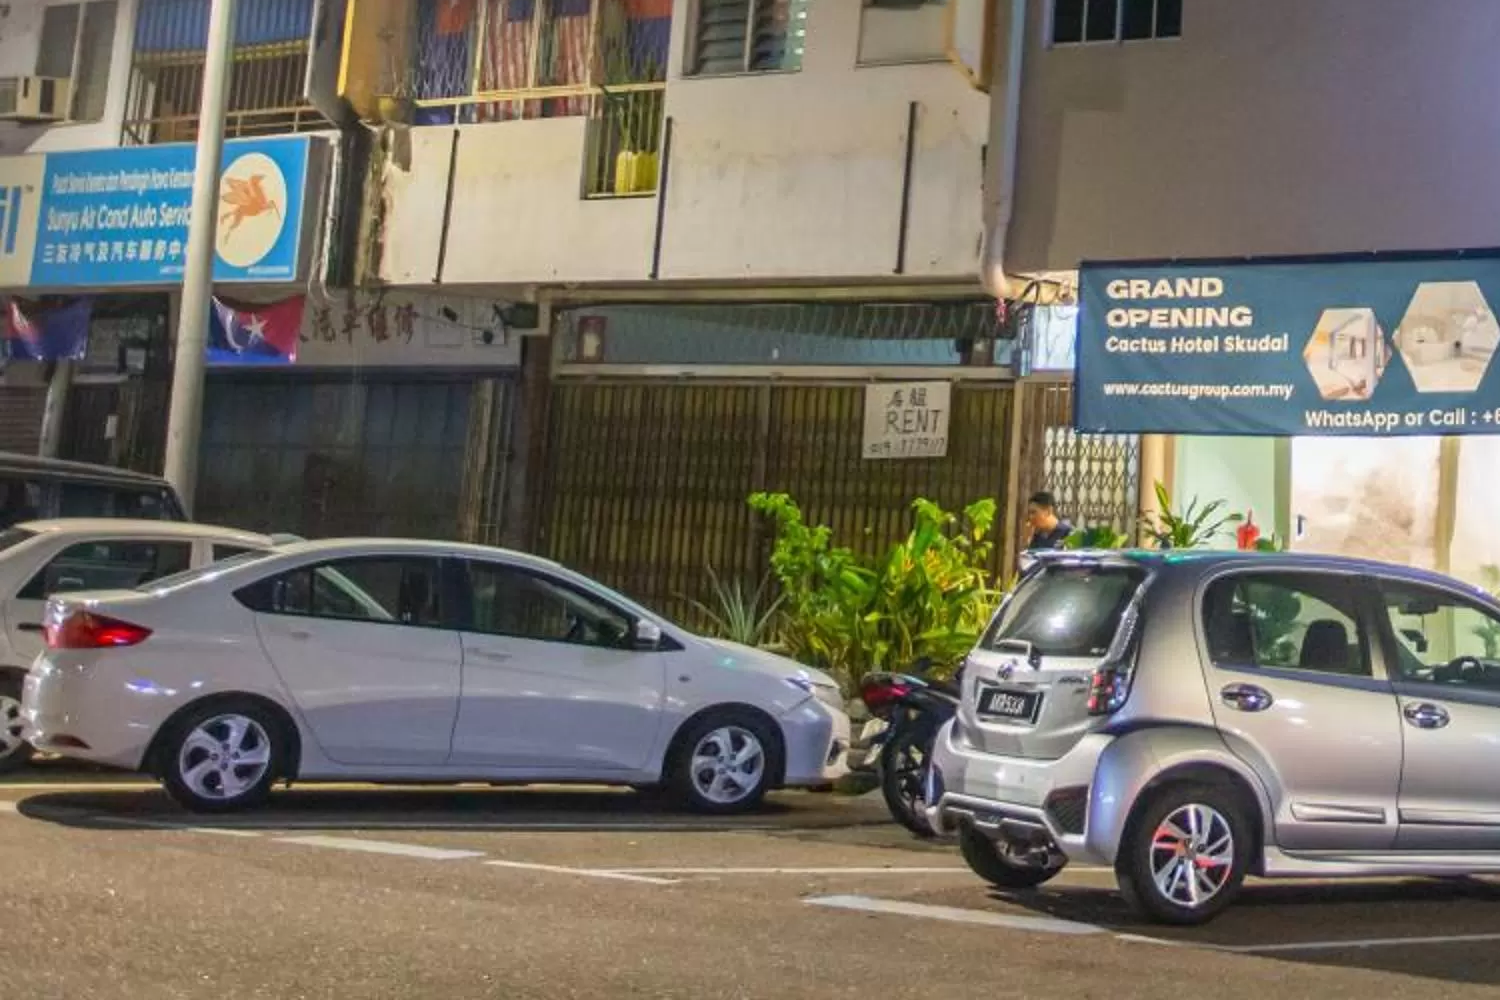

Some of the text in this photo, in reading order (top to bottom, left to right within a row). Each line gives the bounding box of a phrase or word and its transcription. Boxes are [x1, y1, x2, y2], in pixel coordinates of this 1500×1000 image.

[1106, 277, 1223, 299] GRAND
[1106, 306, 1253, 328] OPENING
[1105, 336, 1166, 352] Cactus
[1170, 336, 1220, 353] Hotel
[1103, 381, 1295, 401] www.cactusgroup.com.my
[884, 408, 943, 434] RENT
[1305, 410, 1399, 431] WhatsApp
[1404, 412, 1424, 426] or
[1429, 409, 1465, 426] Call
